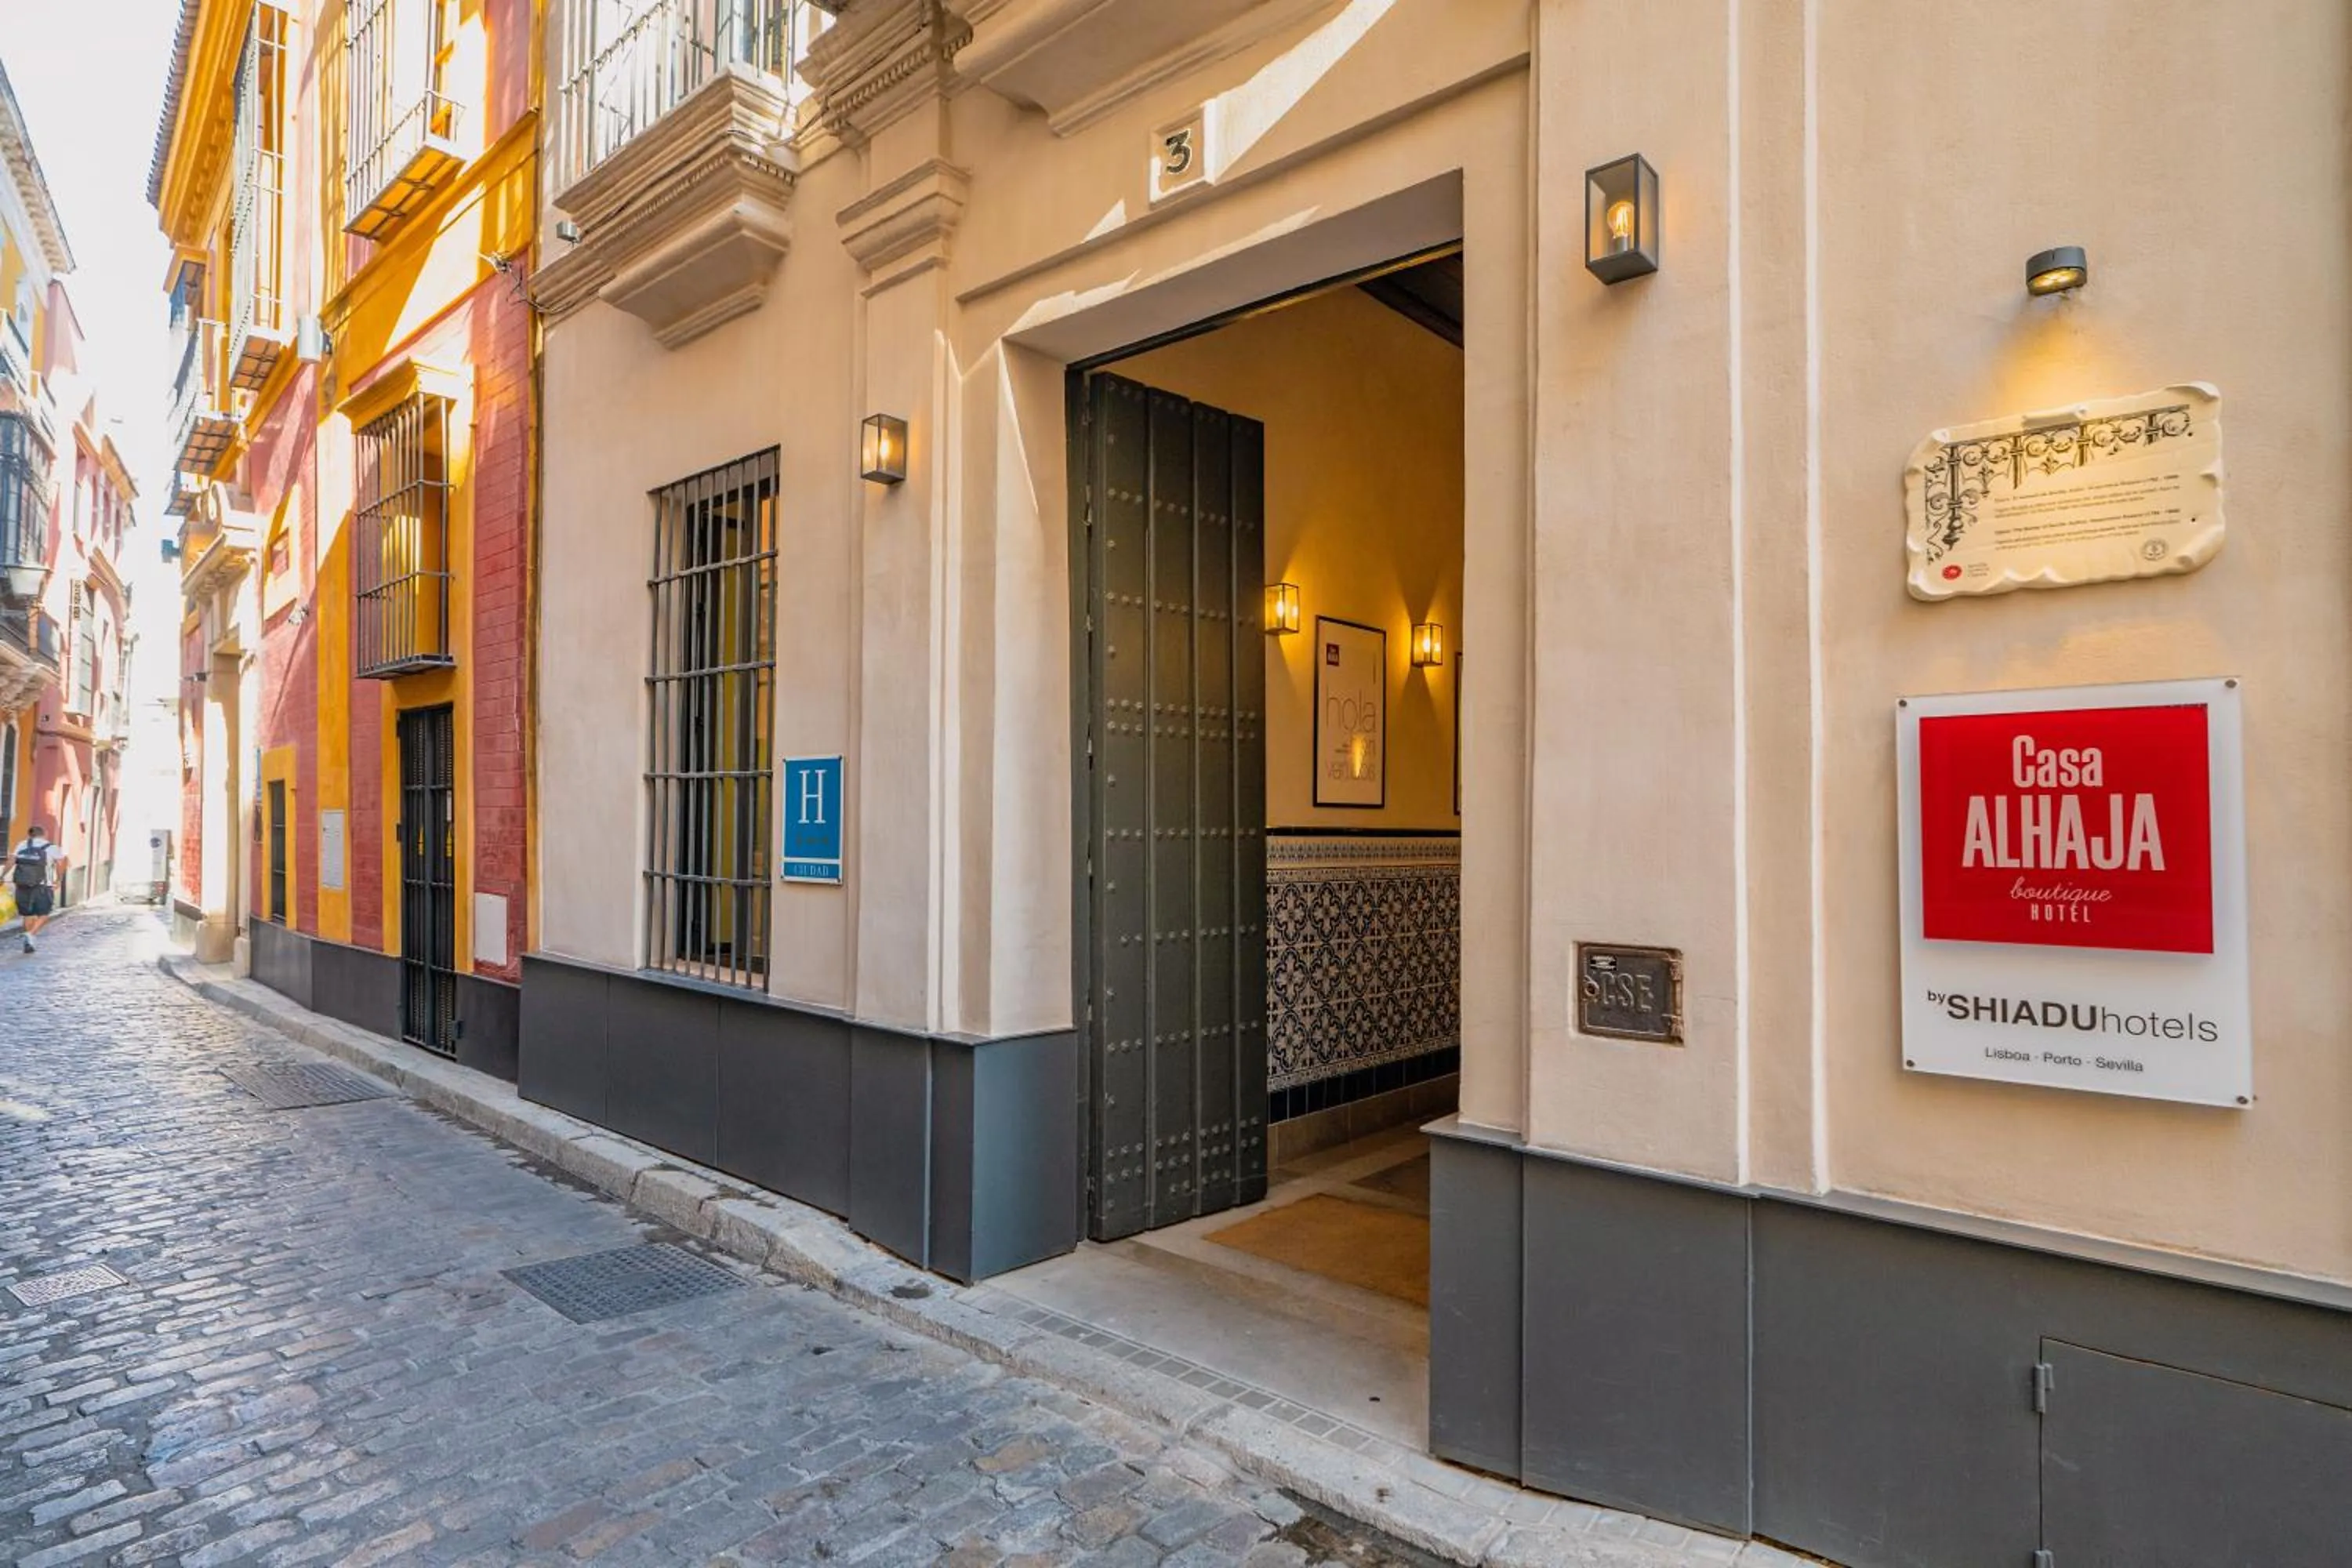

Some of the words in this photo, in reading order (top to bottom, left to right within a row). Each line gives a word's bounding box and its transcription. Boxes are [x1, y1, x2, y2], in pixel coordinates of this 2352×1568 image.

[1165, 130, 1191, 173] 3
[1326, 686, 1376, 732] hola
[2013, 735, 2103, 788] Casa
[798, 769, 826, 823] H
[1962, 793, 2165, 871] ALHAJA
[2010, 877, 2112, 905] boutique
[2031, 903, 2090, 923] HOTEL
[1984, 1047, 2031, 1062] Lisboa
[2043, 1051, 2082, 1066] Porto
[2095, 1056, 2144, 1073] Sevilla
